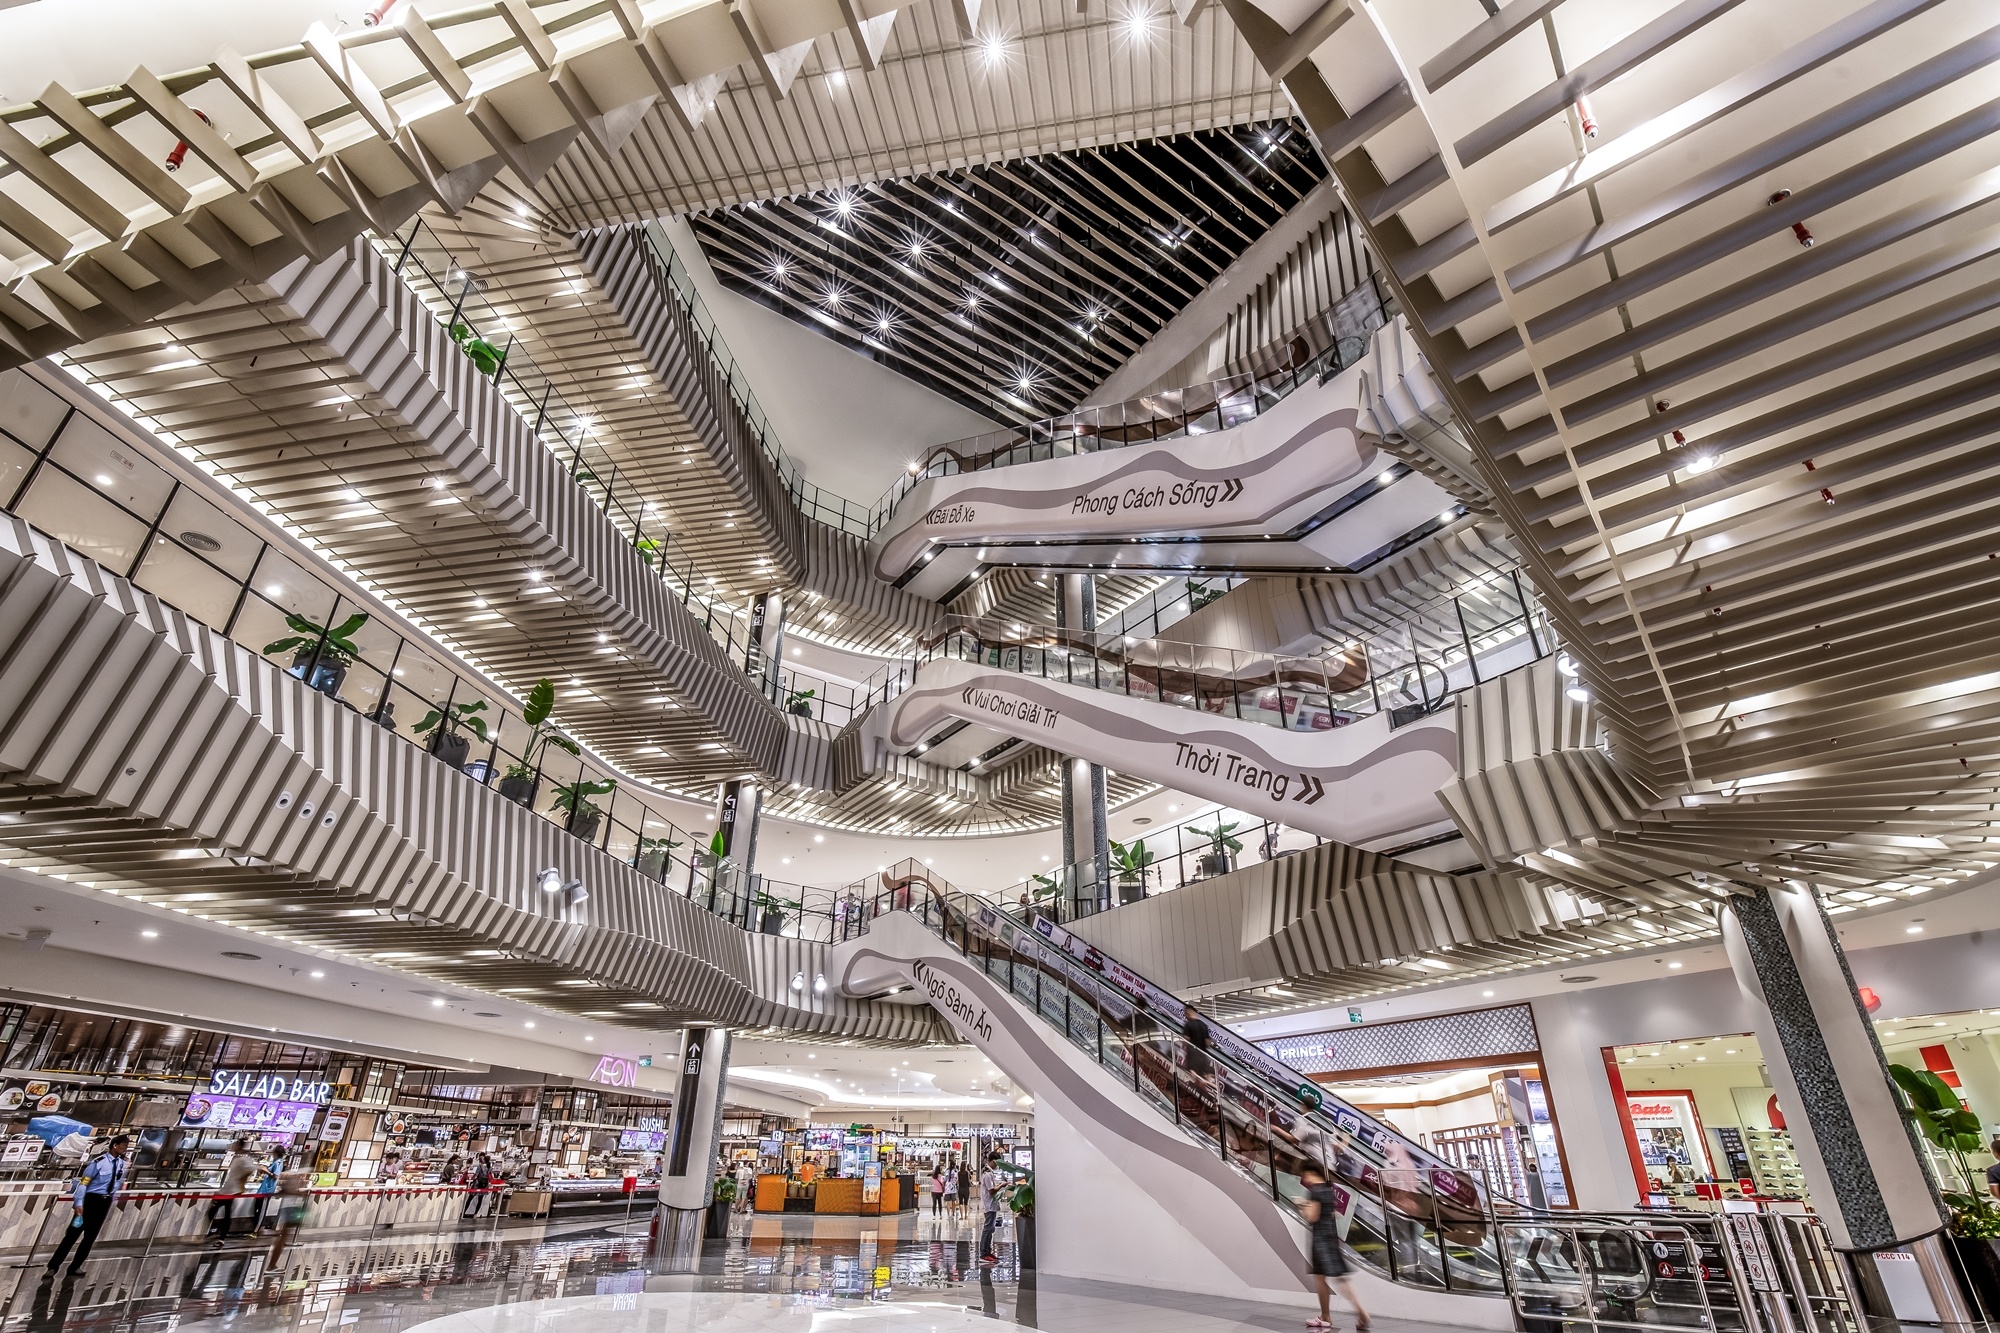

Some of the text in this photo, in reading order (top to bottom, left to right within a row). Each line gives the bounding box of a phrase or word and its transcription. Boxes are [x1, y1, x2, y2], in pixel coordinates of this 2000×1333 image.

[1072, 479, 1219, 516] Phong Cách Sống
[934, 508, 950, 525] Bãi
[961, 506, 976, 523] Xe
[974, 689, 1060, 729] Vui Chơi Giải Trí
[1175, 741, 1290, 802] Thời Trang
[922, 967, 992, 1042] Ngõ Sành Ăn
[1281, 1044, 1326, 1060] PRINCE
[210, 1070, 330, 1104] SALAD BAR
[1630, 1103, 1673, 1116] Bata
[640, 1117, 667, 1132] SUSHI
[949, 1127, 1016, 1138] AEON BAKERY
[1341, 1116, 1357, 1132] Zalo
[1875, 1252, 1896, 1260] PCCC
